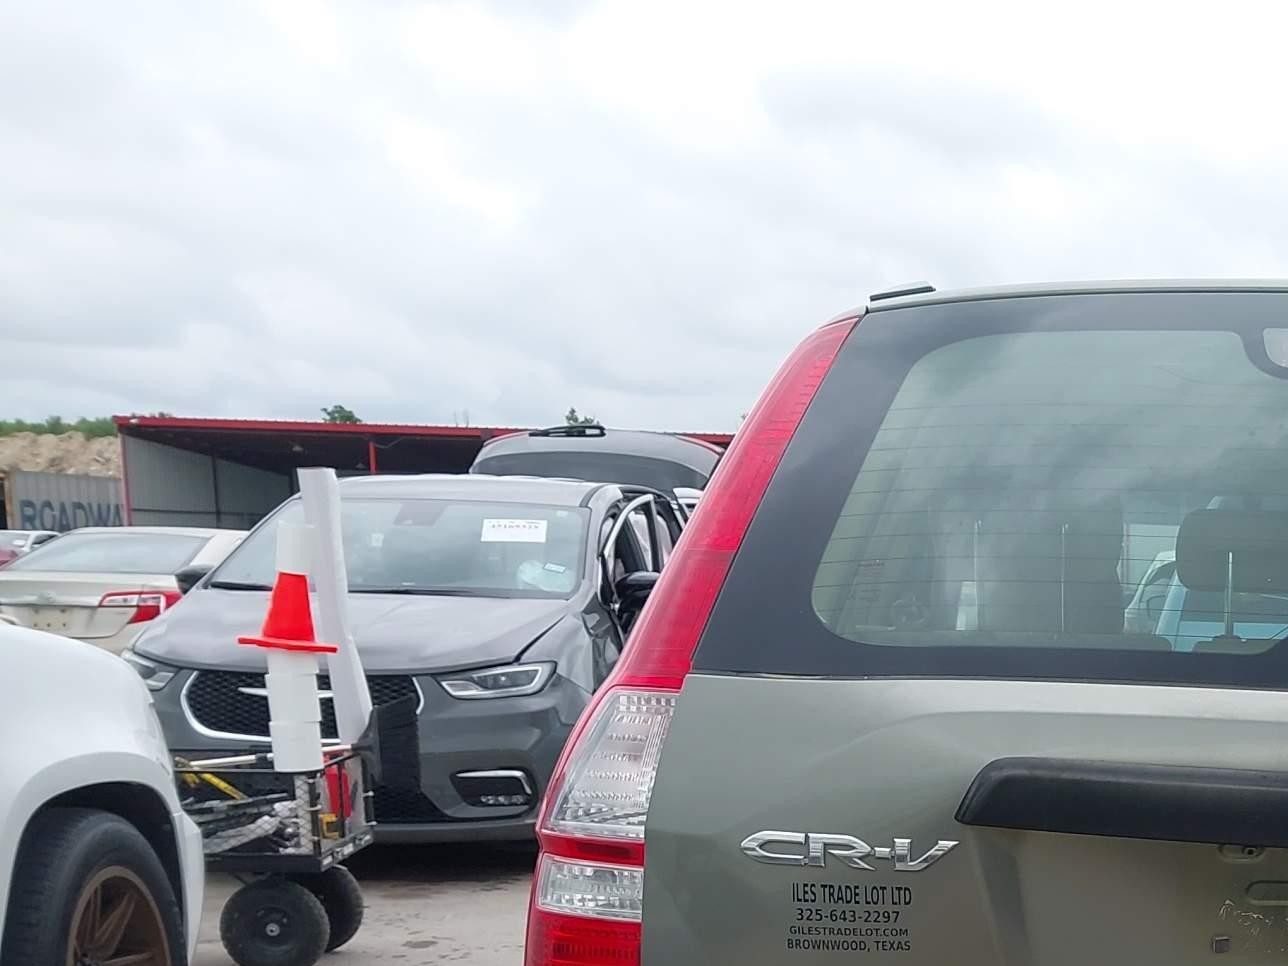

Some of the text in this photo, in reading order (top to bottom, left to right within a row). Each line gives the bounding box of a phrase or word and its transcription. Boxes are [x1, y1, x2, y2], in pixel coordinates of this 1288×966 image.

[20, 500, 126, 530] ROADWA
[740, 830, 960, 872] CR-V
[792, 883, 912, 906] ILES TRADE LOT LTD
[796, 908, 900, 923] 325-643-2297
[789, 925, 909, 937] GILESTRADELOT.COM
[787, 938, 911, 952] BROWNWOOD, TEXAS
